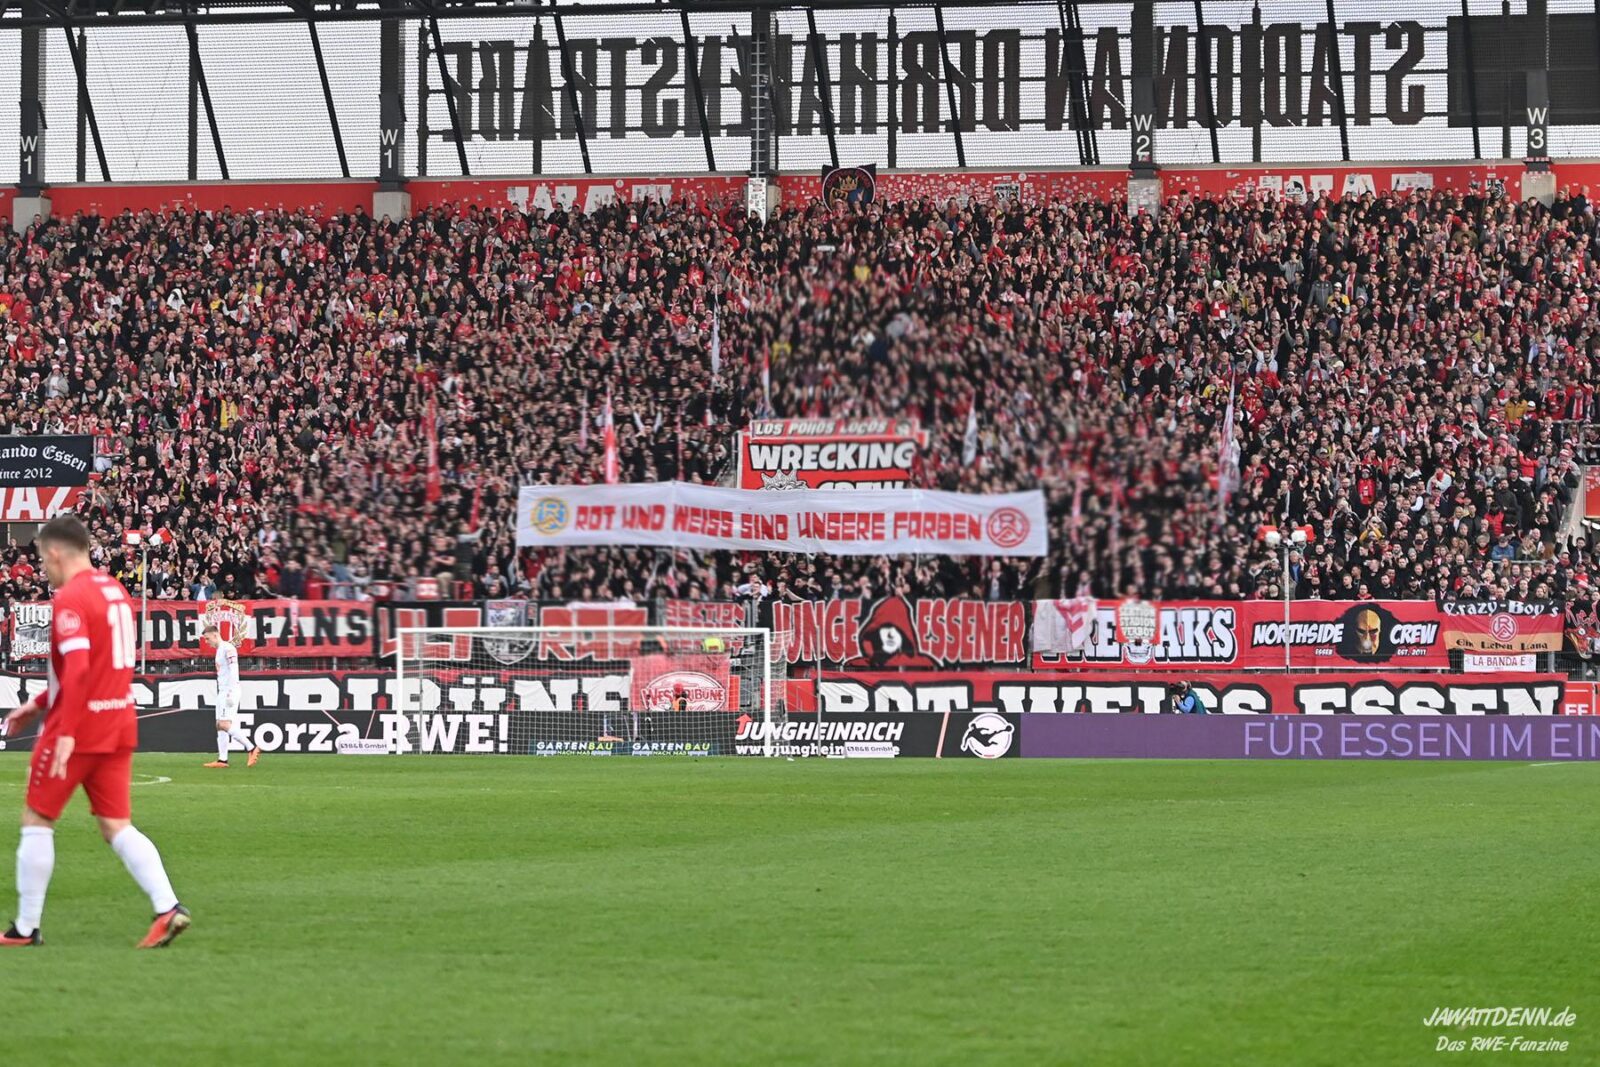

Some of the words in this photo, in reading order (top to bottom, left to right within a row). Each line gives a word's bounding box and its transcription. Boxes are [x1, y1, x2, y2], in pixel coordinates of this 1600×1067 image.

[1132, 113, 1153, 132] W
[1527, 107, 1548, 125] W
[20, 135, 38, 152] W
[380, 128, 398, 145] W
[1135, 135, 1151, 156] 2
[1530, 129, 1545, 149] 3
[25, 155, 33, 174] 1
[385, 149, 393, 168] 1
[0, 444, 37, 459] ando
[42, 445, 87, 472] Essen
[750, 441, 915, 471] WRECKING
[23, 467, 53, 479] 2012
[0, 486, 74, 519] AZ
[575, 505, 616, 530] ROT
[622, 504, 666, 531] UND
[672, 504, 734, 538] WEISS
[741, 512, 788, 541] SIND
[796, 511, 885, 542] UNSERE
[893, 510, 982, 540] FARBEN
[137, 609, 199, 649] DE
[254, 607, 375, 647] FANS
[770, 599, 862, 663] JUNGE
[917, 598, 1026, 664] ESSENER
[1041, 607, 1236, 662] EAKS
[1252, 621, 1344, 646] NORTHSIDE
[1389, 621, 1438, 646] CREW
[1472, 655, 1484, 667] LA
[1486, 655, 1518, 667] BANDA
[1300, 684, 1559, 715] ESSEN
[380, 714, 509, 753] RWE!
[735, 721, 904, 741] JUNGHEINRICH
[1244, 716, 1324, 756] FÜR
[1340, 721, 1471, 758] ESSEN
[1490, 721, 1532, 758] IM
[536, 741, 614, 751] GARTENBAU
[632, 742, 711, 751] GARTENBAU
